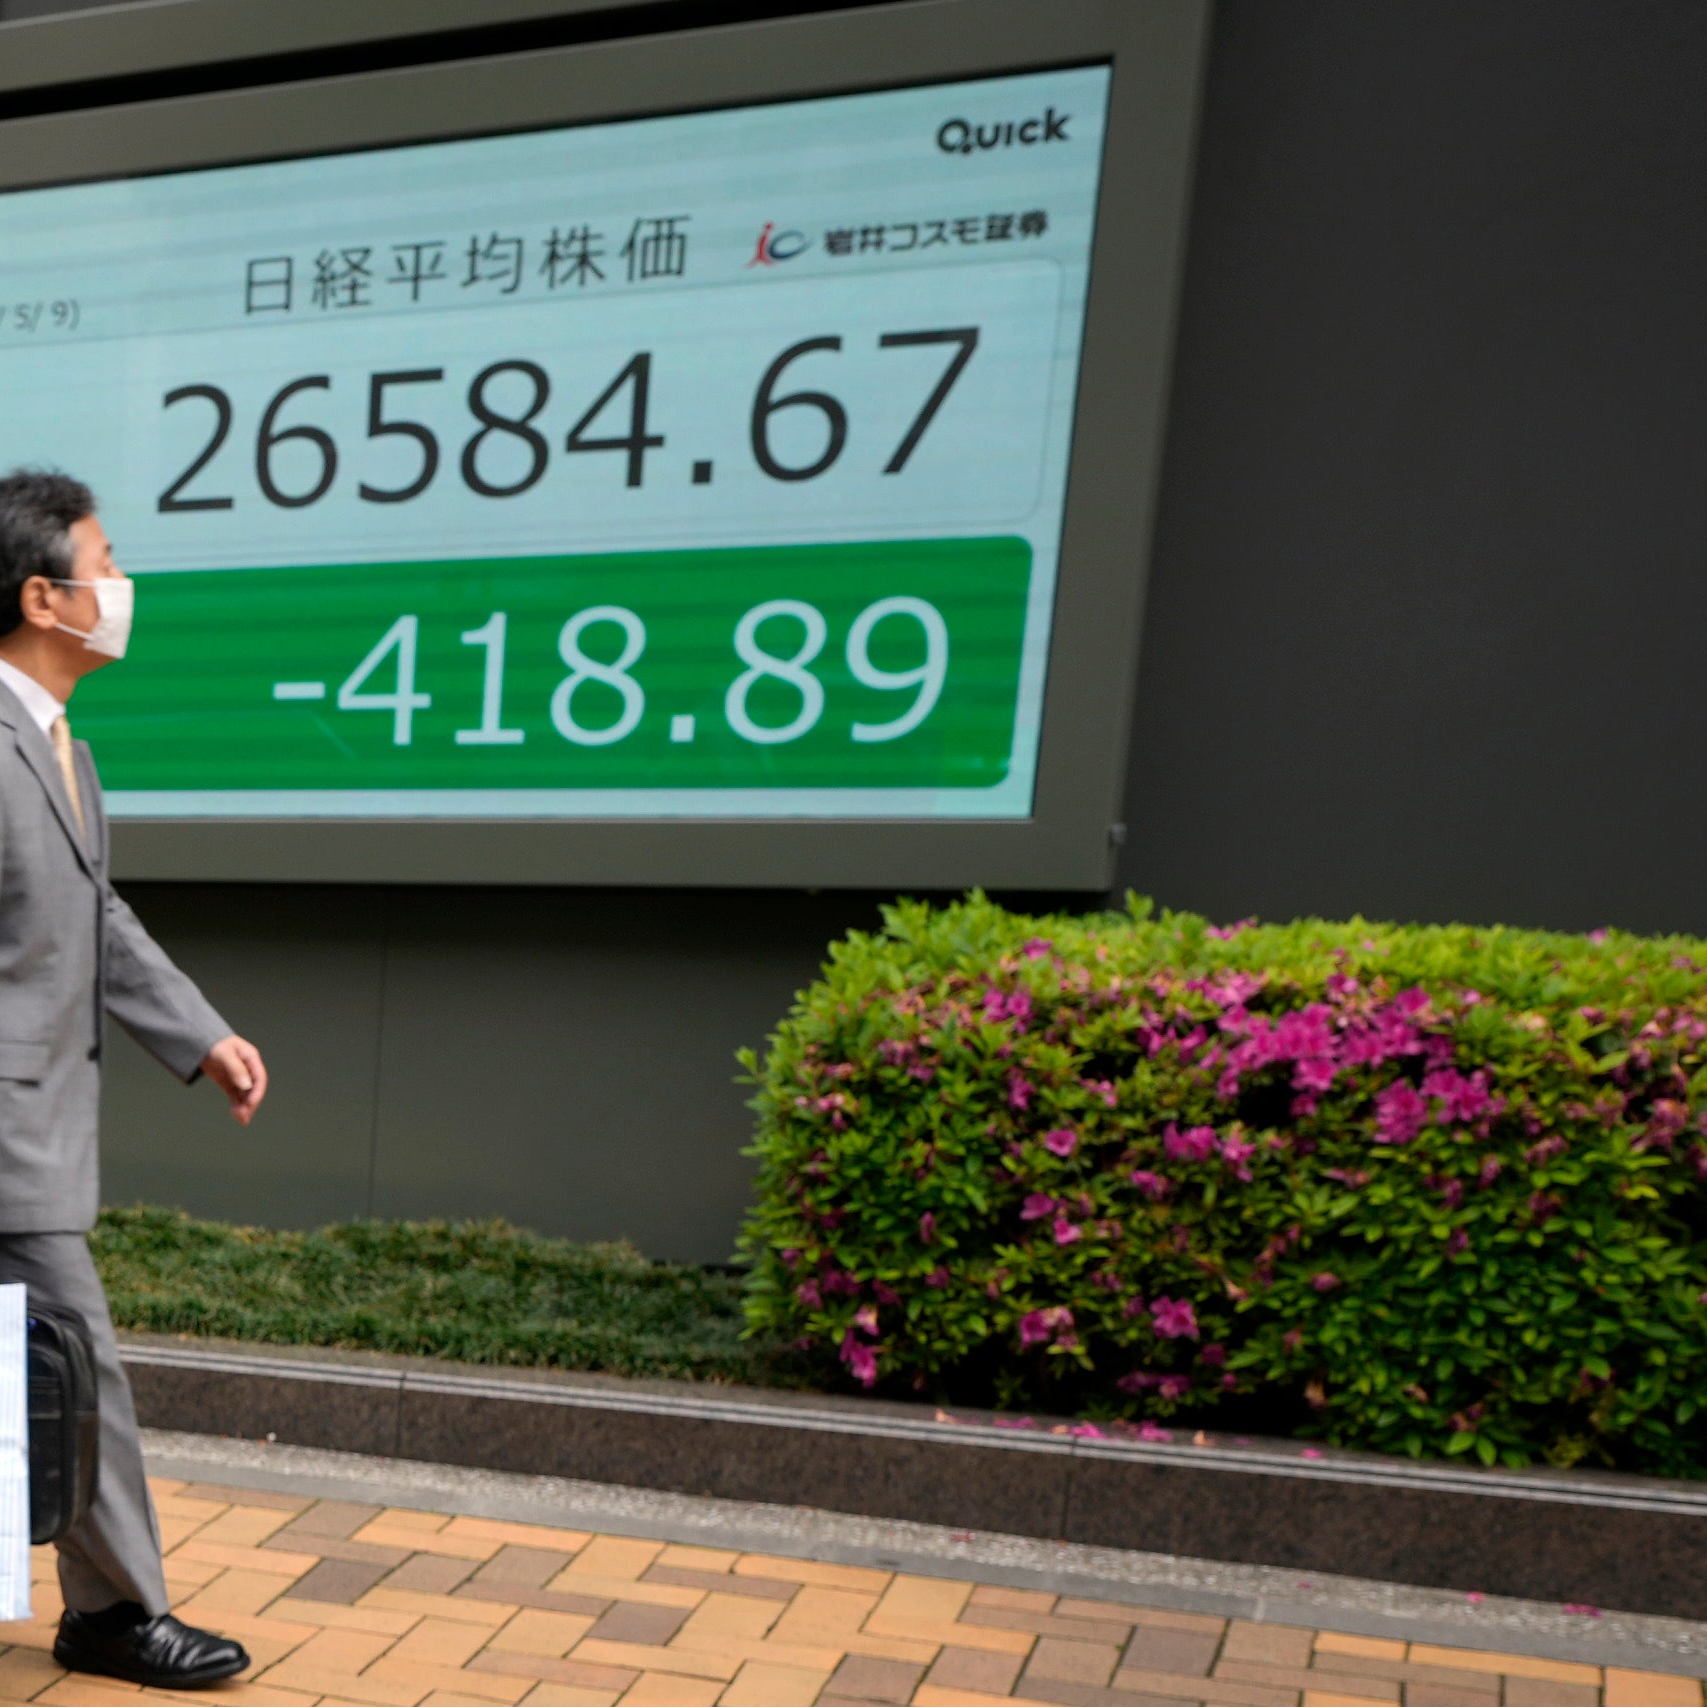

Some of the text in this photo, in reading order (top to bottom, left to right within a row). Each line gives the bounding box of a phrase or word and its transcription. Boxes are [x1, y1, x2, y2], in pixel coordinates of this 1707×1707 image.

[936, 106, 1073, 155] Quick
[240, 212, 694, 318] 日経平均株価
[823, 208, 1050, 258] 岩井コスモ証券
[153, 324, 982, 518] 26584.67
[271, 593, 953, 752] -418.89
